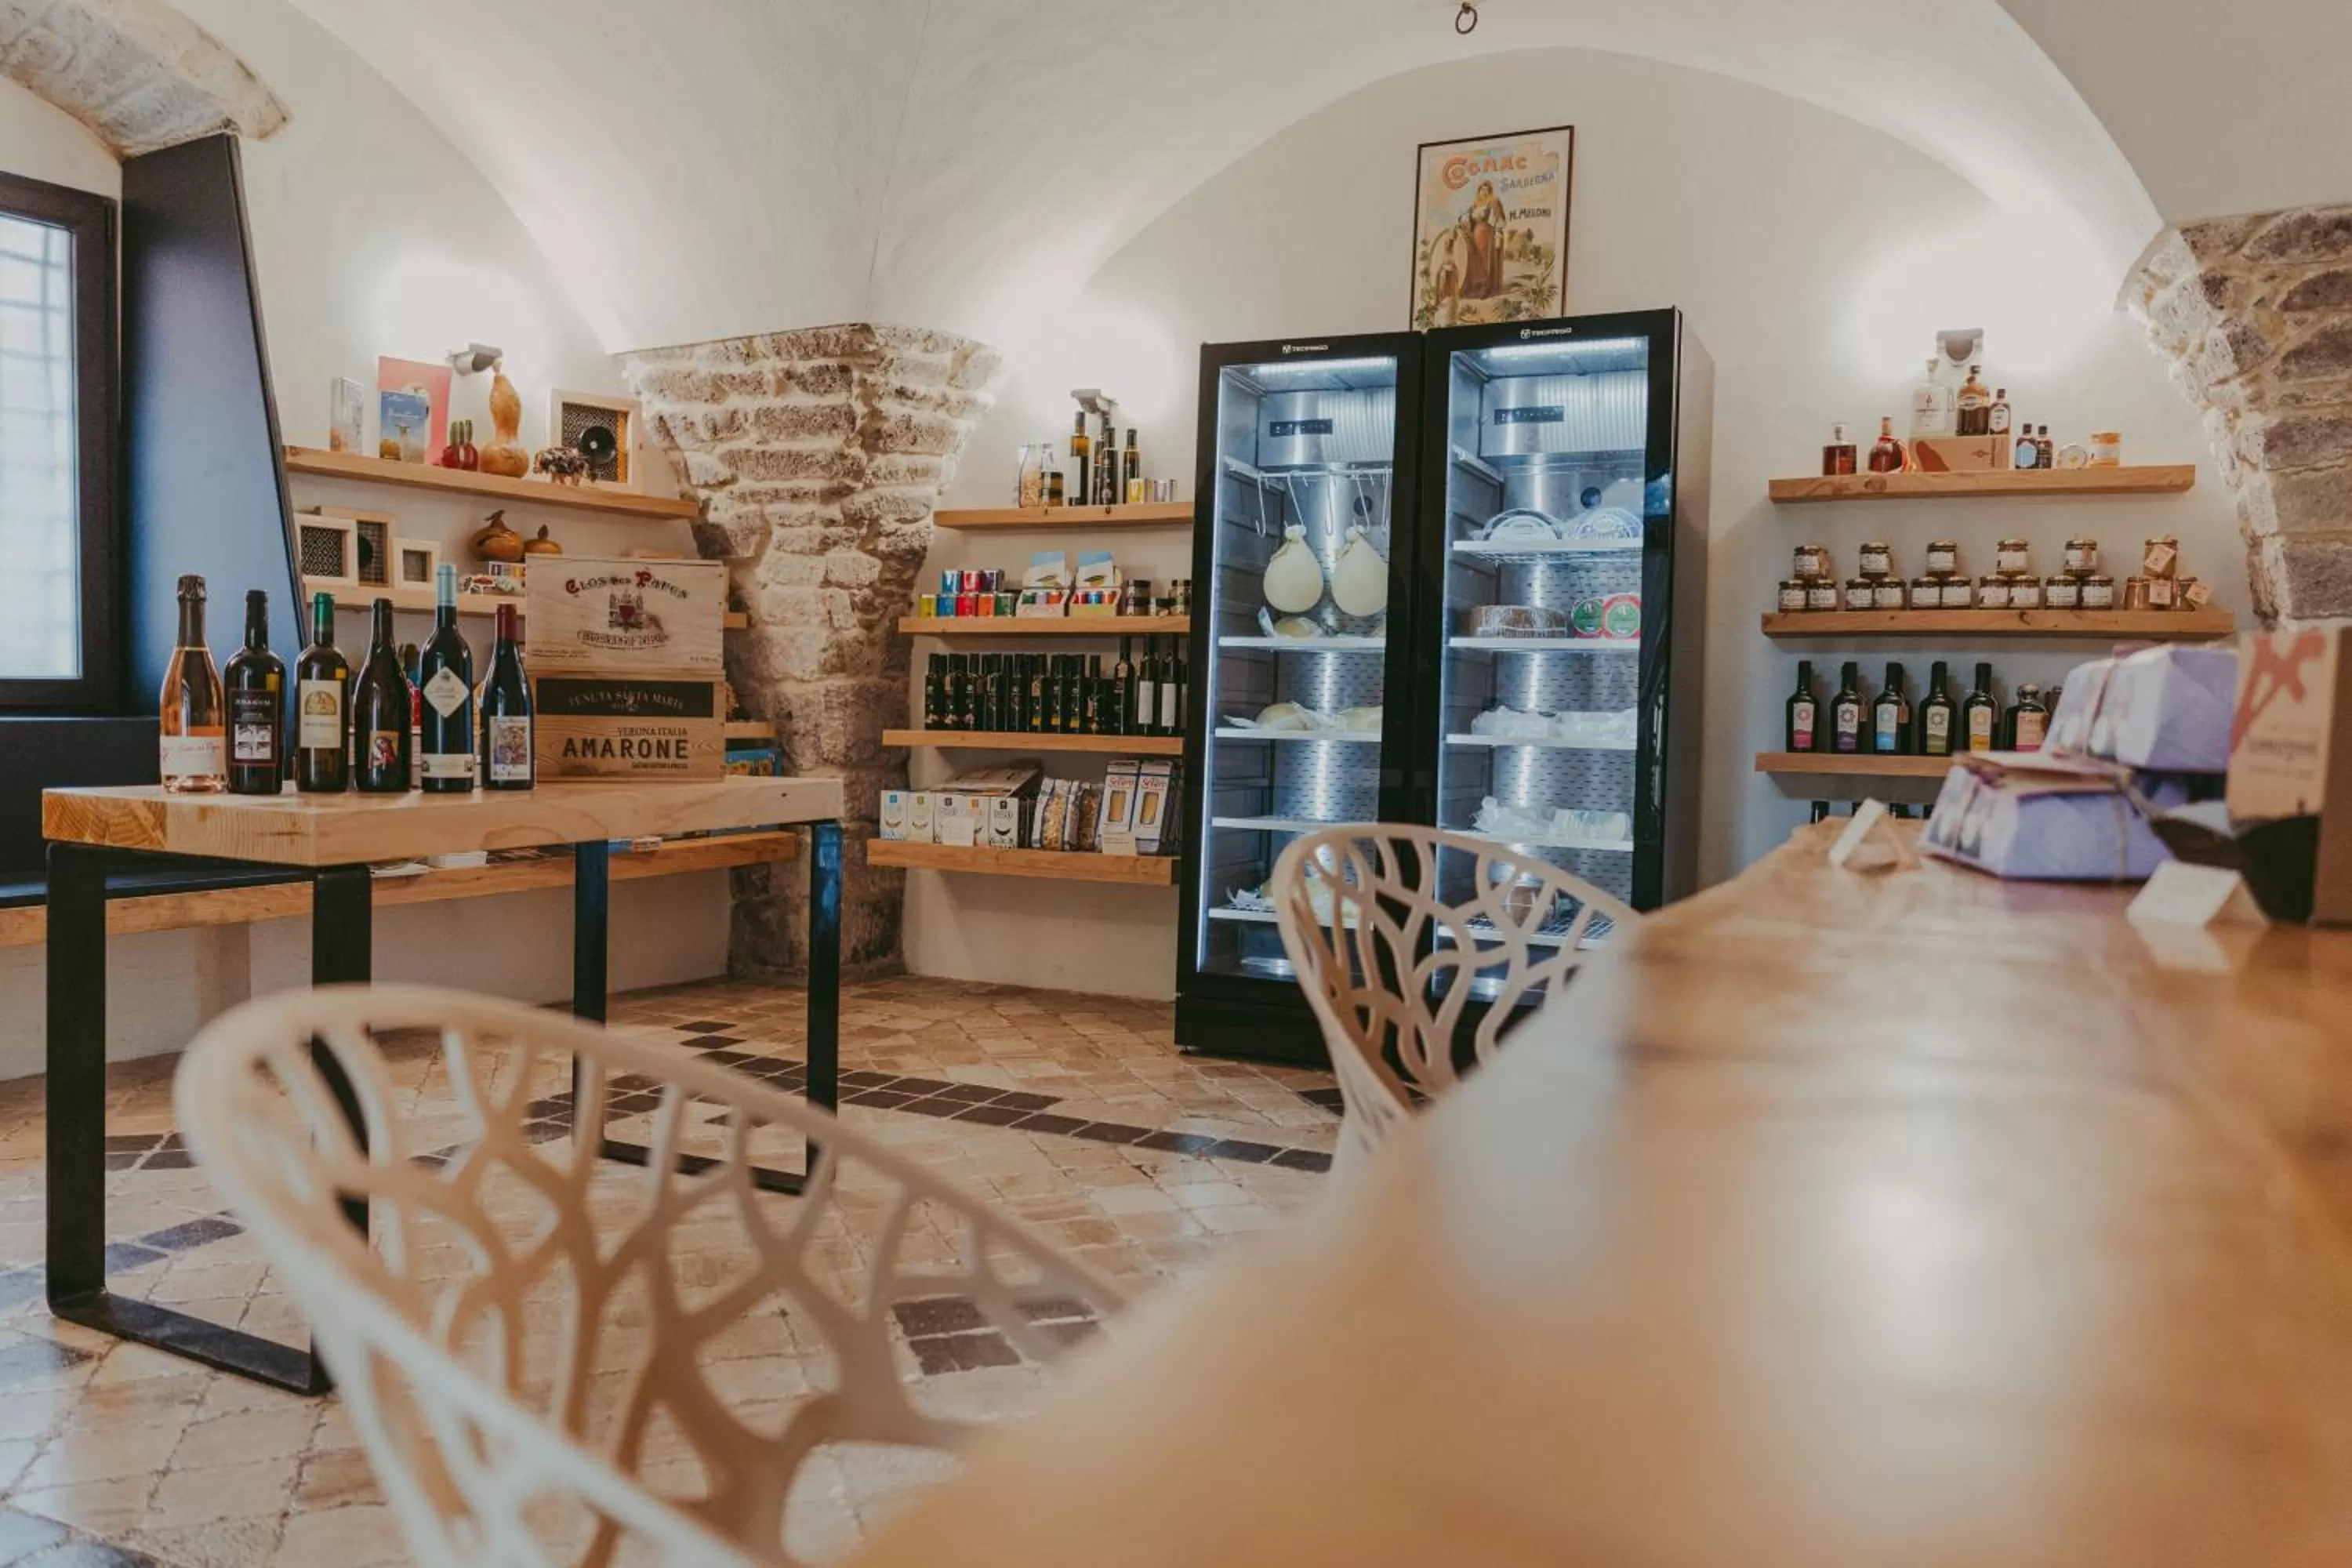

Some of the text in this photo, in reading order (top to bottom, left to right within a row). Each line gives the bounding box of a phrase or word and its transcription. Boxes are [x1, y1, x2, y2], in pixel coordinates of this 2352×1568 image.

[568, 691, 613, 707] TENUTA
[652, 693, 684, 710] MARIA
[618, 727, 688, 737] VERONA ITALIA
[561, 737, 690, 760] AMARONE
